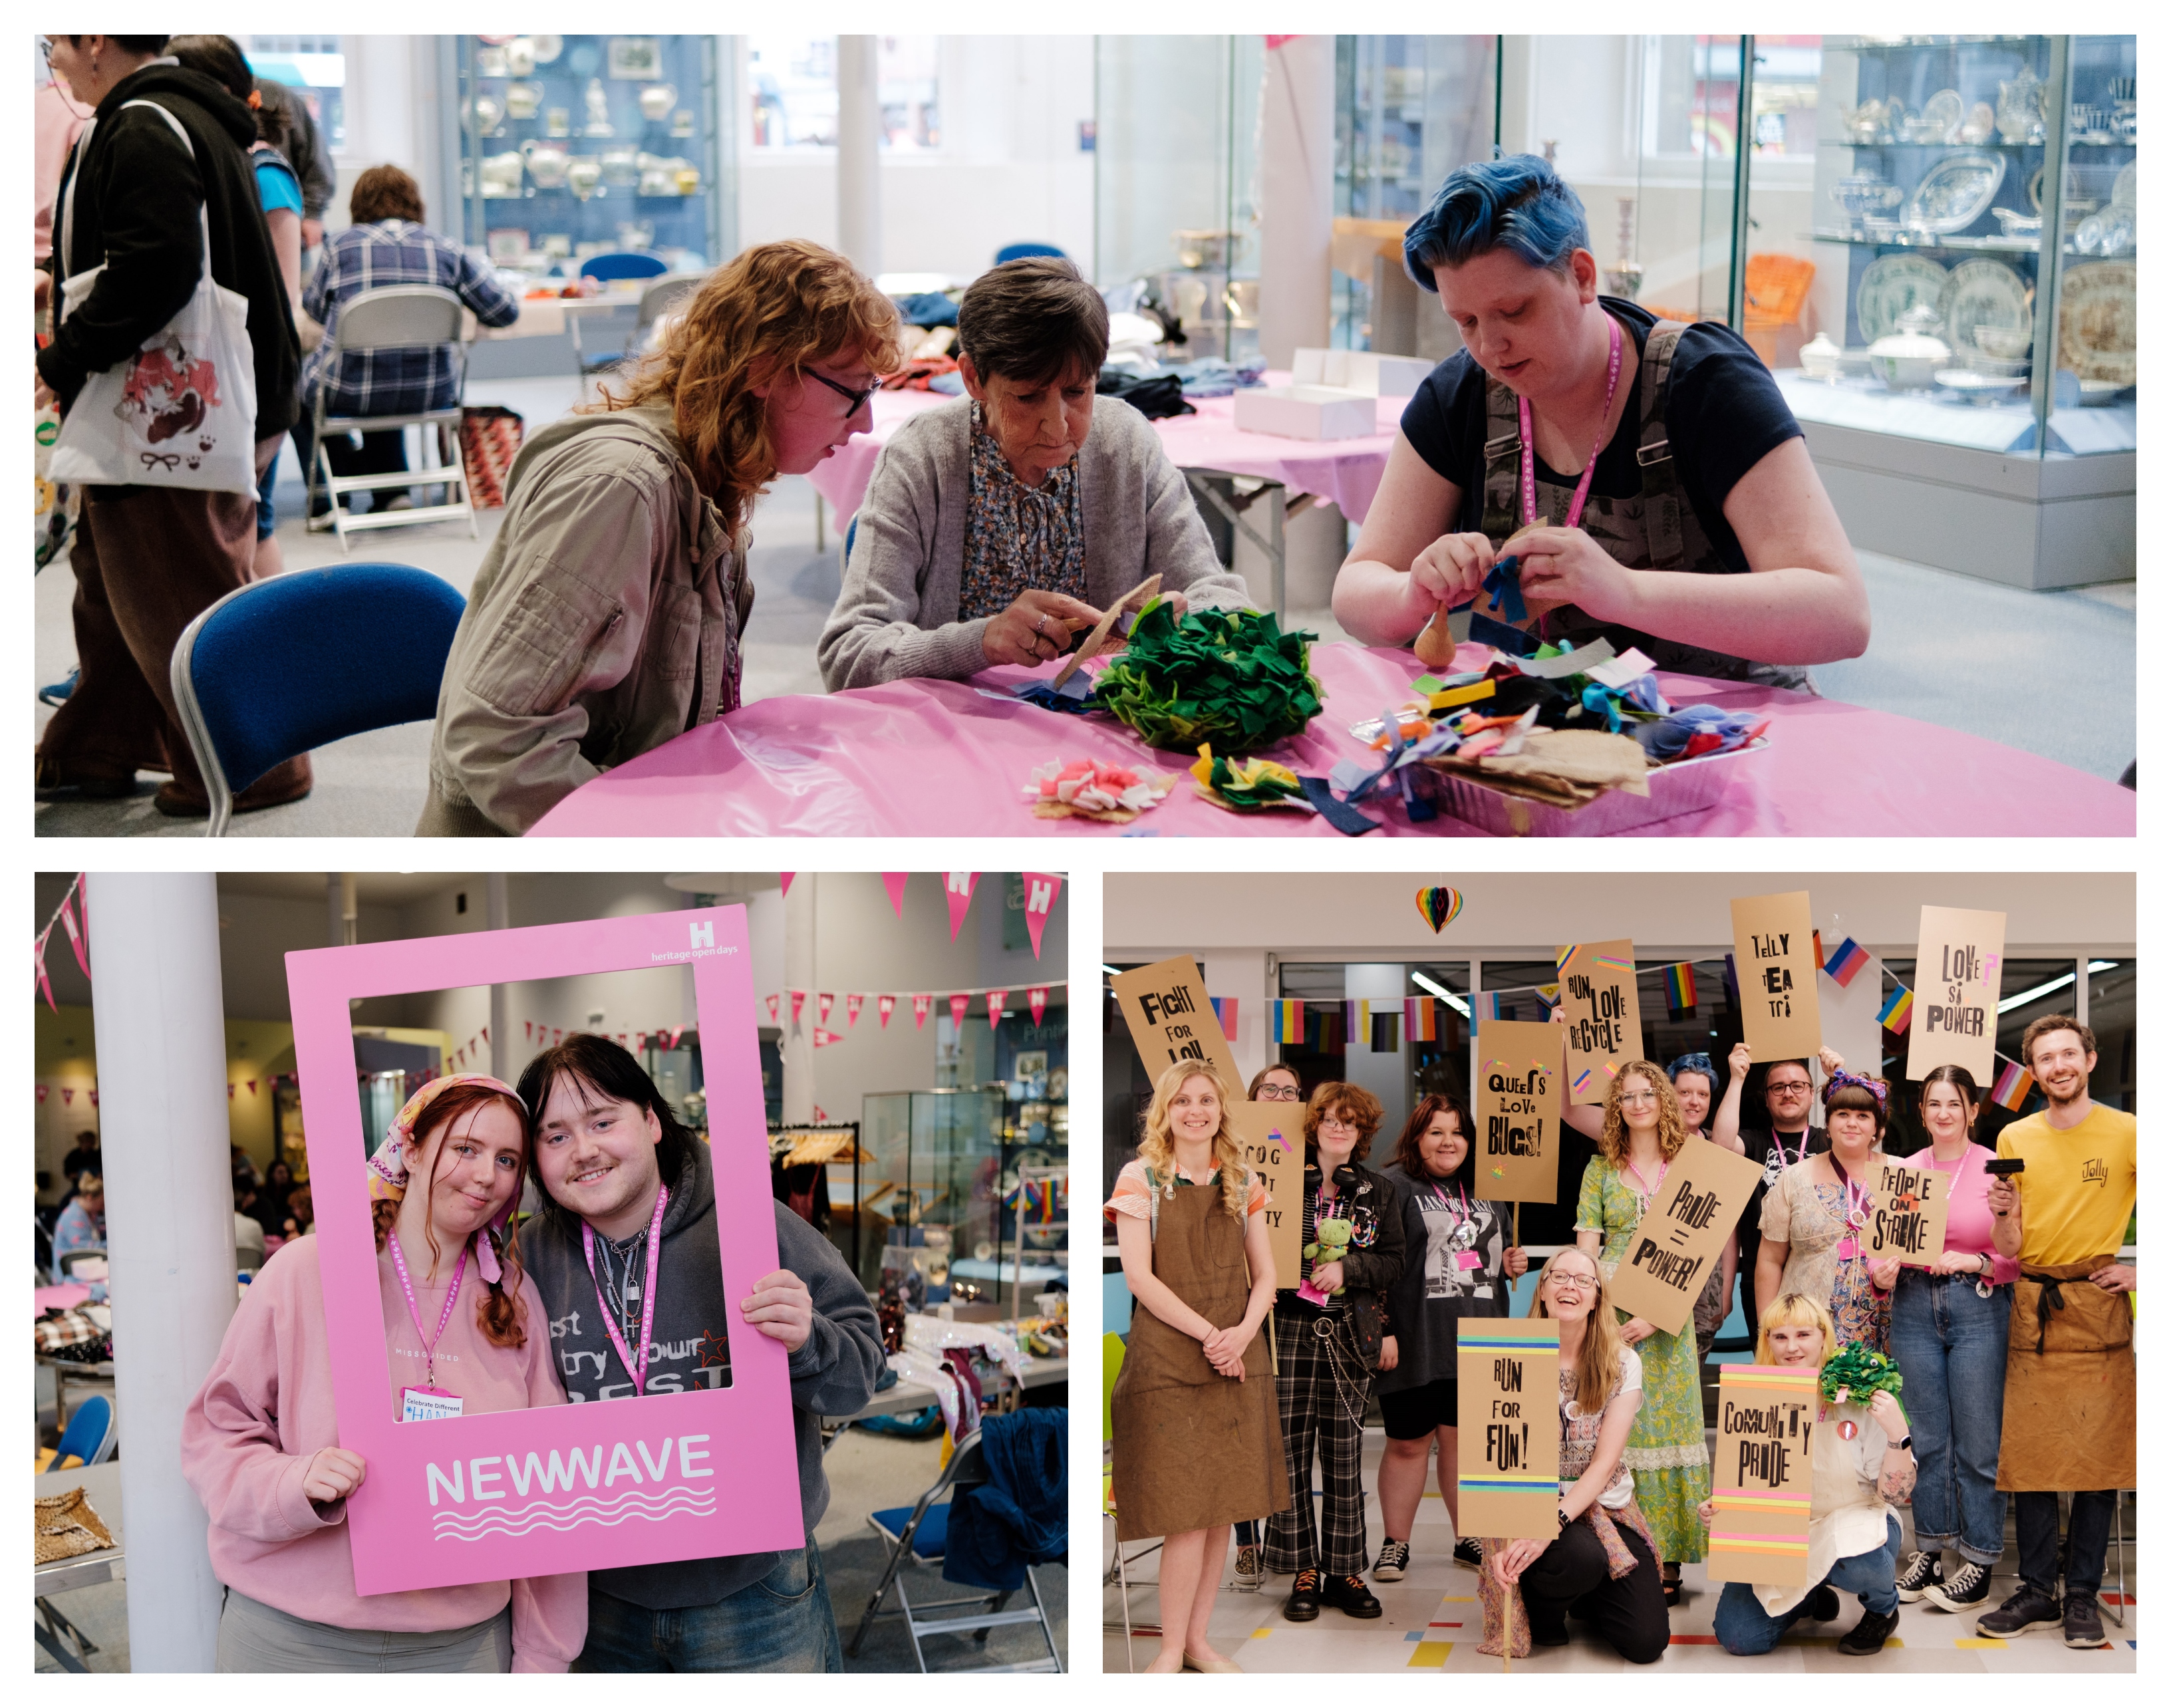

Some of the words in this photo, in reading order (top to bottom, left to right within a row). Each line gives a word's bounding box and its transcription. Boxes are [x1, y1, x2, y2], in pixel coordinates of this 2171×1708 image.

[651, 951, 690, 961] heritage
[692, 948, 715, 958] open
[716, 945, 738, 956] days
[1568, 974, 1591, 1000] RUN
[1762, 966, 1794, 994] TEA
[1138, 986, 1196, 1026] FIGHT
[1590, 985, 1626, 1023] LOVE
[1165, 1025, 1193, 1042] FOR
[1488, 1115, 1542, 1157] BUGS!
[1880, 1166, 1932, 1201] PEOPLE
[2082, 1158, 2108, 1187] Jolly
[1414, 1195, 1449, 1211] LANA
[1666, 1179, 1722, 1230] PRIDE
[1890, 1198, 1910, 1211] ON
[1872, 1209, 1929, 1254] STRIKE
[1632, 1237, 1705, 1292] POWER!
[396, 1348, 459, 1362] MISSGUIDED
[1494, 1357, 1522, 1393] RUN
[406, 1397, 434, 1408] Celebrate
[434, 1403, 460, 1412] Different
[1492, 1400, 1521, 1419] FOR
[1487, 1422, 1528, 1472] FUN!
[1738, 1440, 1791, 1489] PRIDE
[426, 1434, 714, 1506] NEWWAVE
